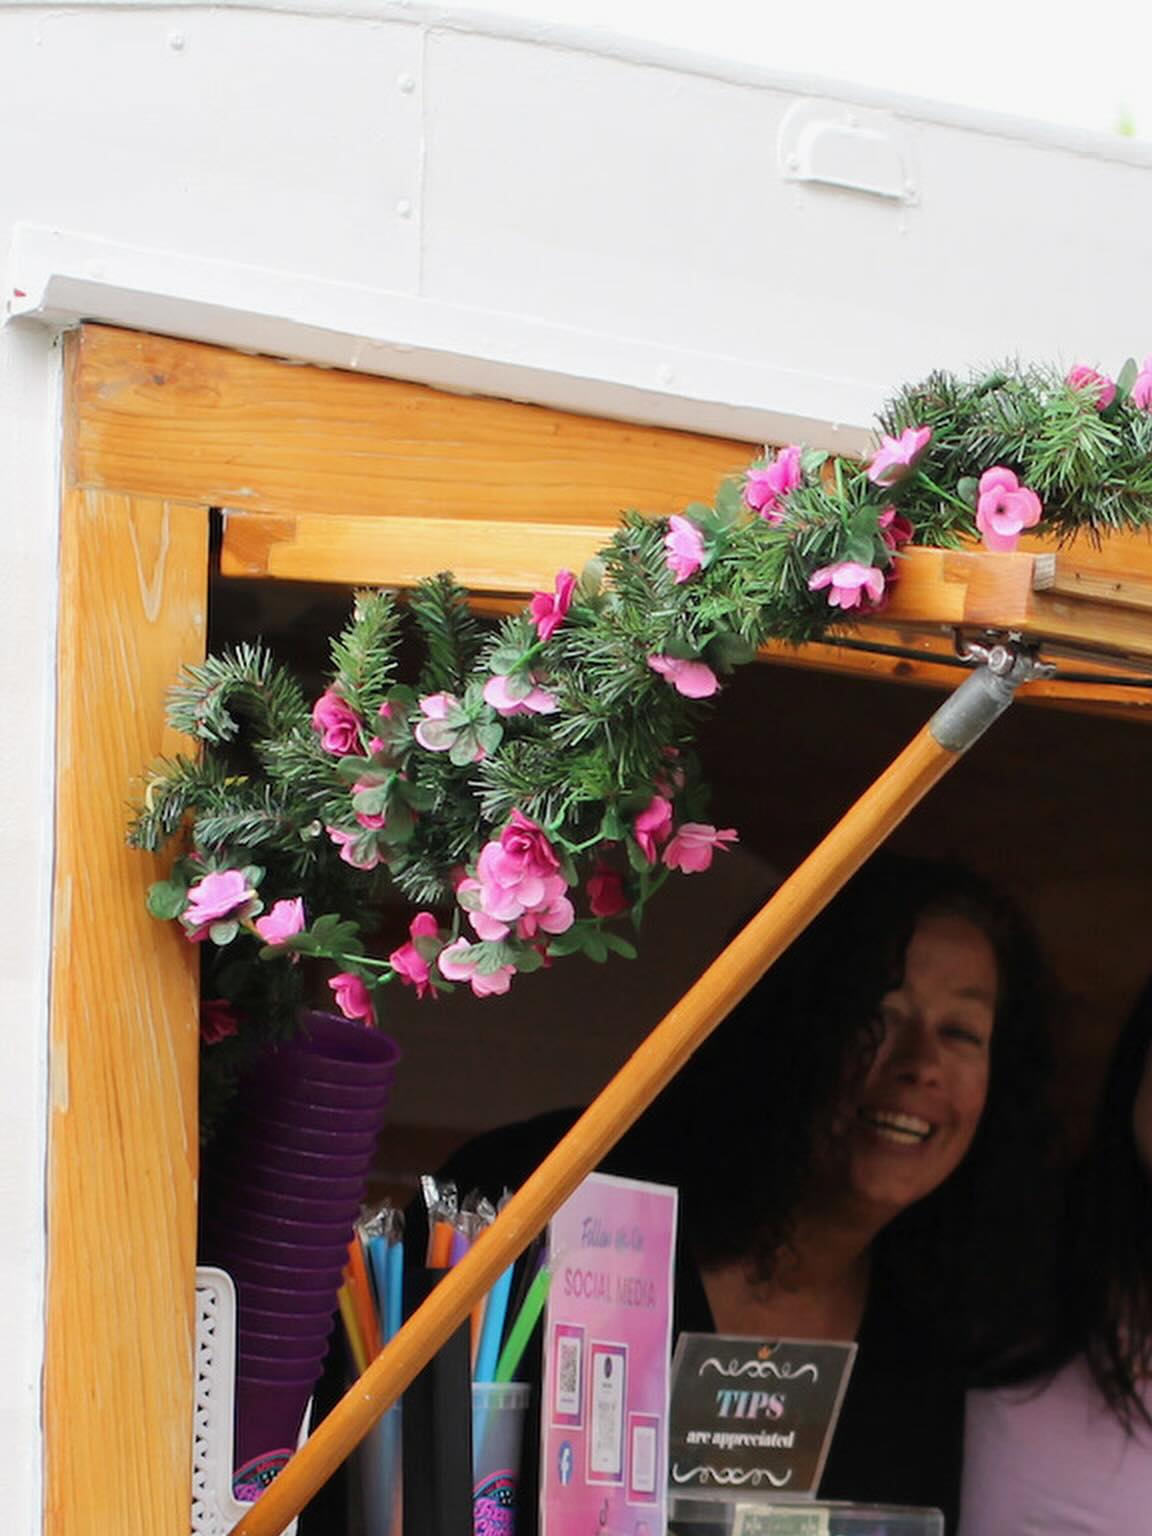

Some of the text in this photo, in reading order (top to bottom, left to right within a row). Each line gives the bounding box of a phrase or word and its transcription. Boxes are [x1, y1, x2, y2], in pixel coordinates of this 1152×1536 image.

[563, 1267, 656, 1308] SOCIAL MEDIA
[717, 1389, 787, 1420] TIPS
[686, 1430, 795, 1450] are appreciated
